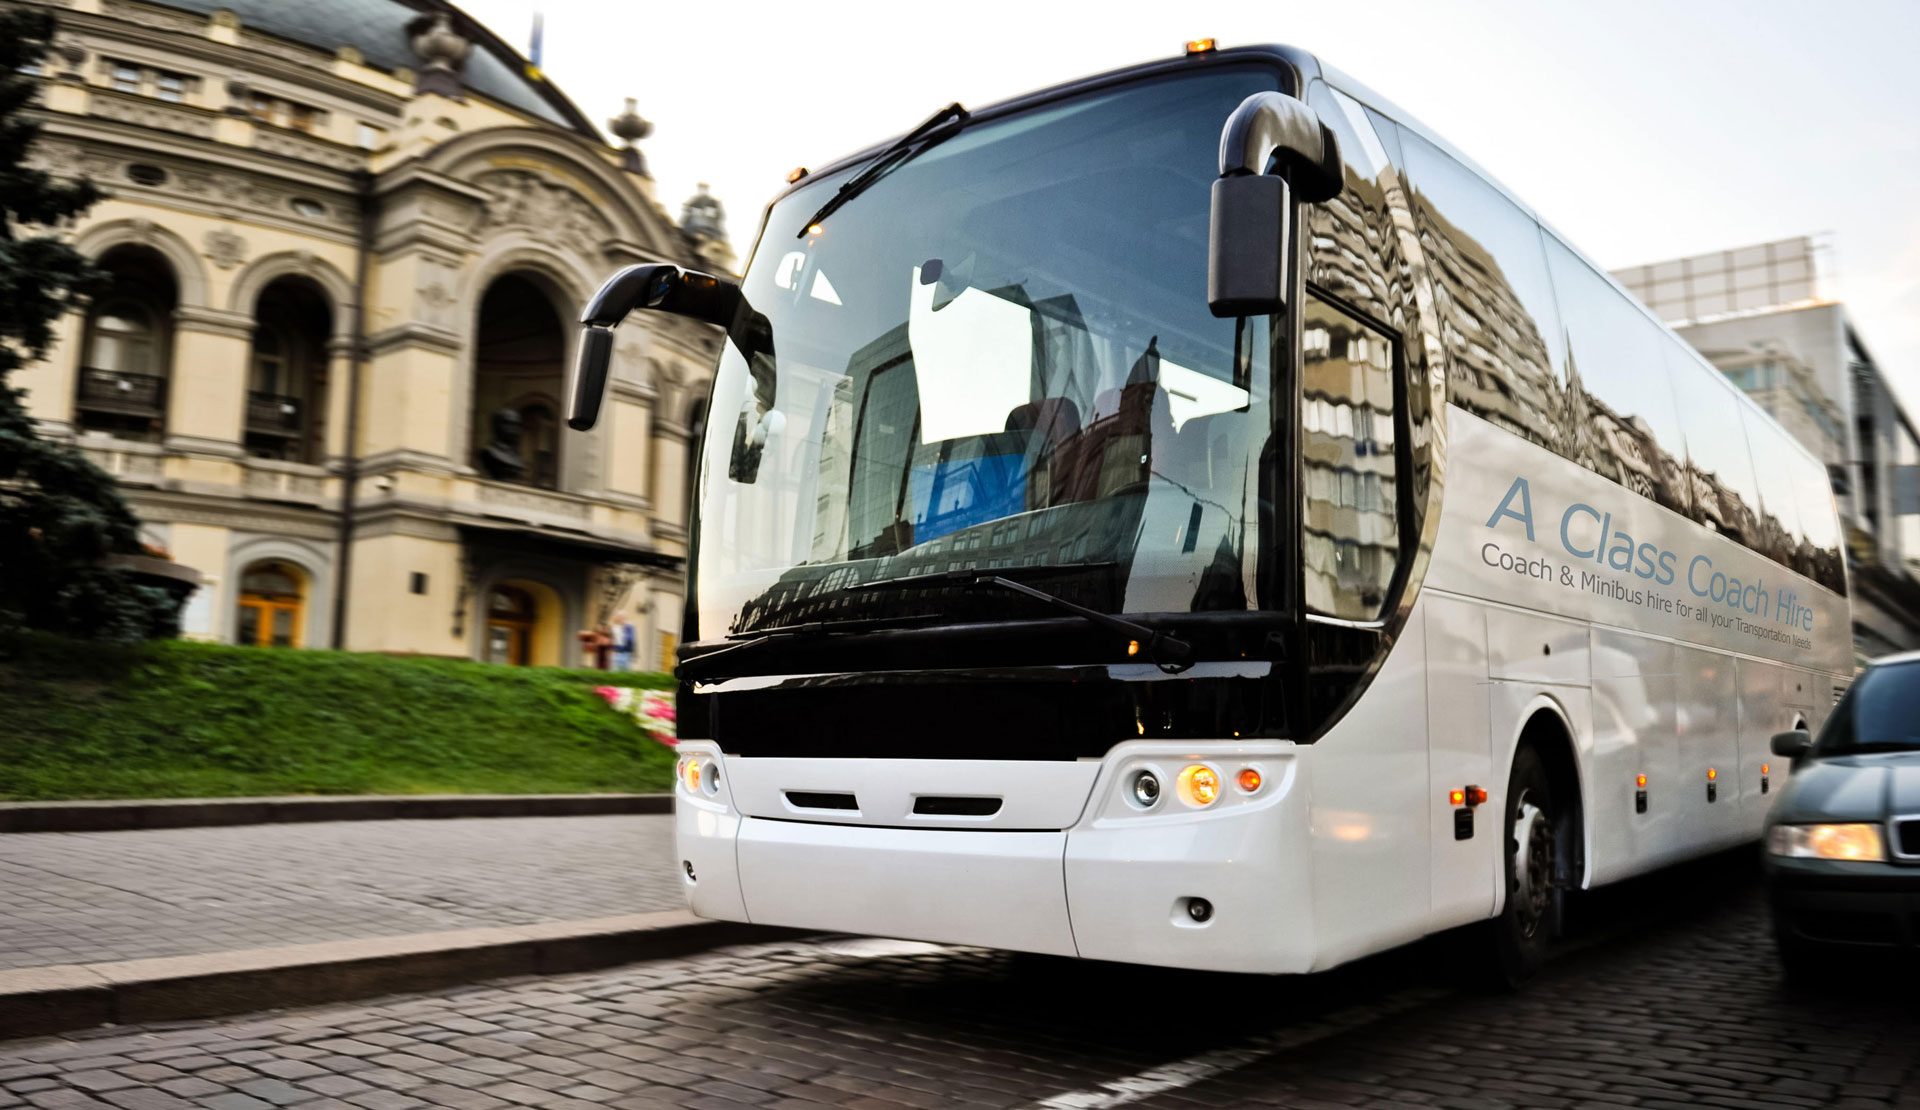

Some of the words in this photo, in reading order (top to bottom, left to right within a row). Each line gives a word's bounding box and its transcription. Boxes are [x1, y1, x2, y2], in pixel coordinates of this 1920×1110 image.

[1481, 542, 1553, 582] Coach
[1560, 565, 1575, 588] &
[1581, 571, 1643, 606] Minibus
[1647, 591, 1673, 613] hire
[1676, 599, 1693, 618] for
[1695, 606, 1709, 622] all
[1710, 611, 1734, 630] your
[1735, 617, 1791, 645] Transportation
[1792, 635, 1812, 650] Needs
[1485, 476, 1536, 542] A
[1560, 503, 1677, 586] Class
[1687, 555, 1769, 617] Coach
[1776, 590, 1813, 632] Hire
